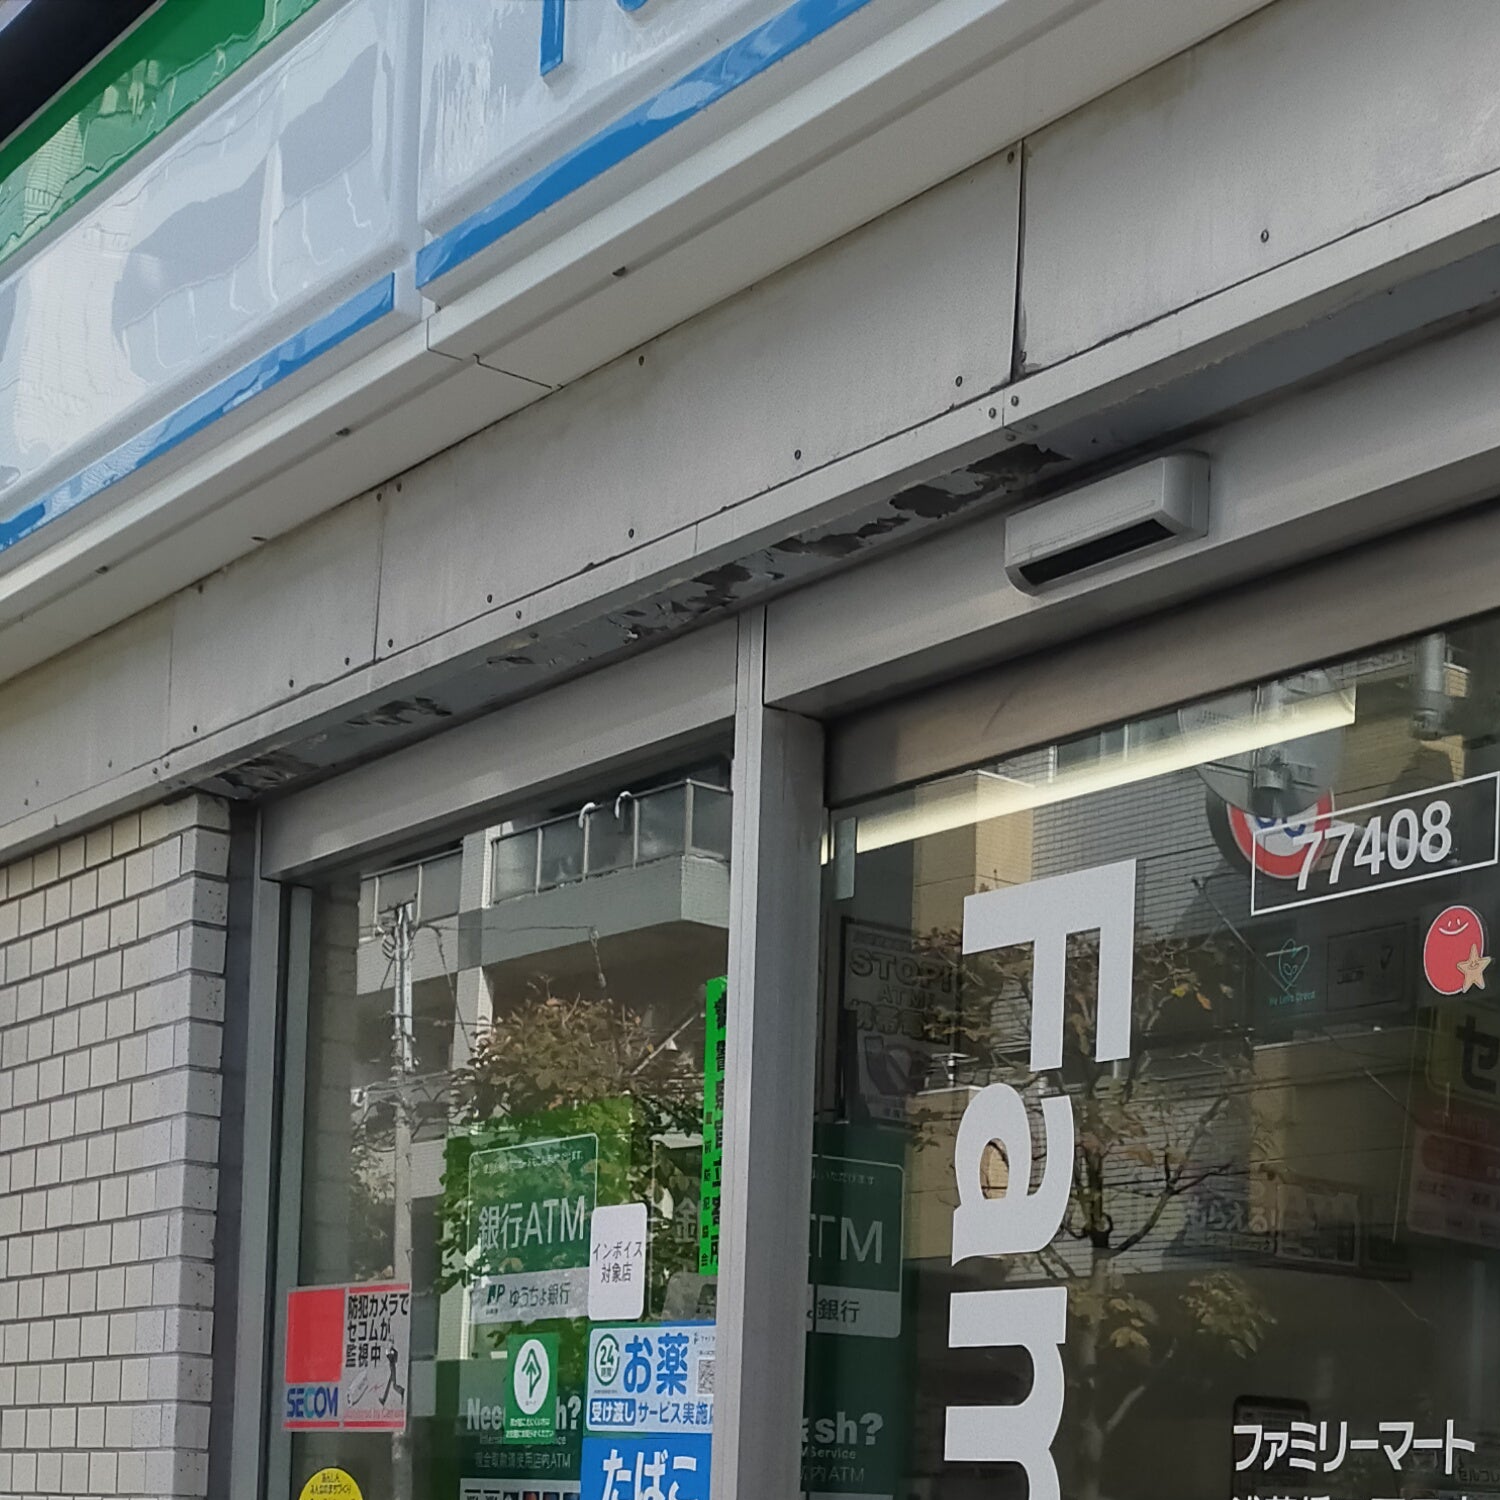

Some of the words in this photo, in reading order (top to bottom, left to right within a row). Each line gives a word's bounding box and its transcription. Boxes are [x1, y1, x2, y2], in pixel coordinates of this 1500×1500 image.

[1292, 800, 1452, 892] 77408
[478, 1195, 585, 1252] 銀行ATM
[592, 1240, 643, 1261] インボイス
[600, 1263, 633, 1284] 対象店
[347, 1293, 409, 1319] 防犯カメラで
[509, 1282, 572, 1308] ゆうちょ銀行
[347, 1318, 391, 1342] セコムが
[345, 1343, 381, 1368] 監視中
[599, 1344, 616, 1366] 24
[623, 1332, 690, 1397] お薬
[286, 1386, 339, 1418] SECOM
[467, 1398, 505, 1431] Nee
[592, 1400, 634, 1423] 受け渡し
[638, 1401, 713, 1425] サービス実施
[1233, 1419, 1476, 1475] ファミリーマート
